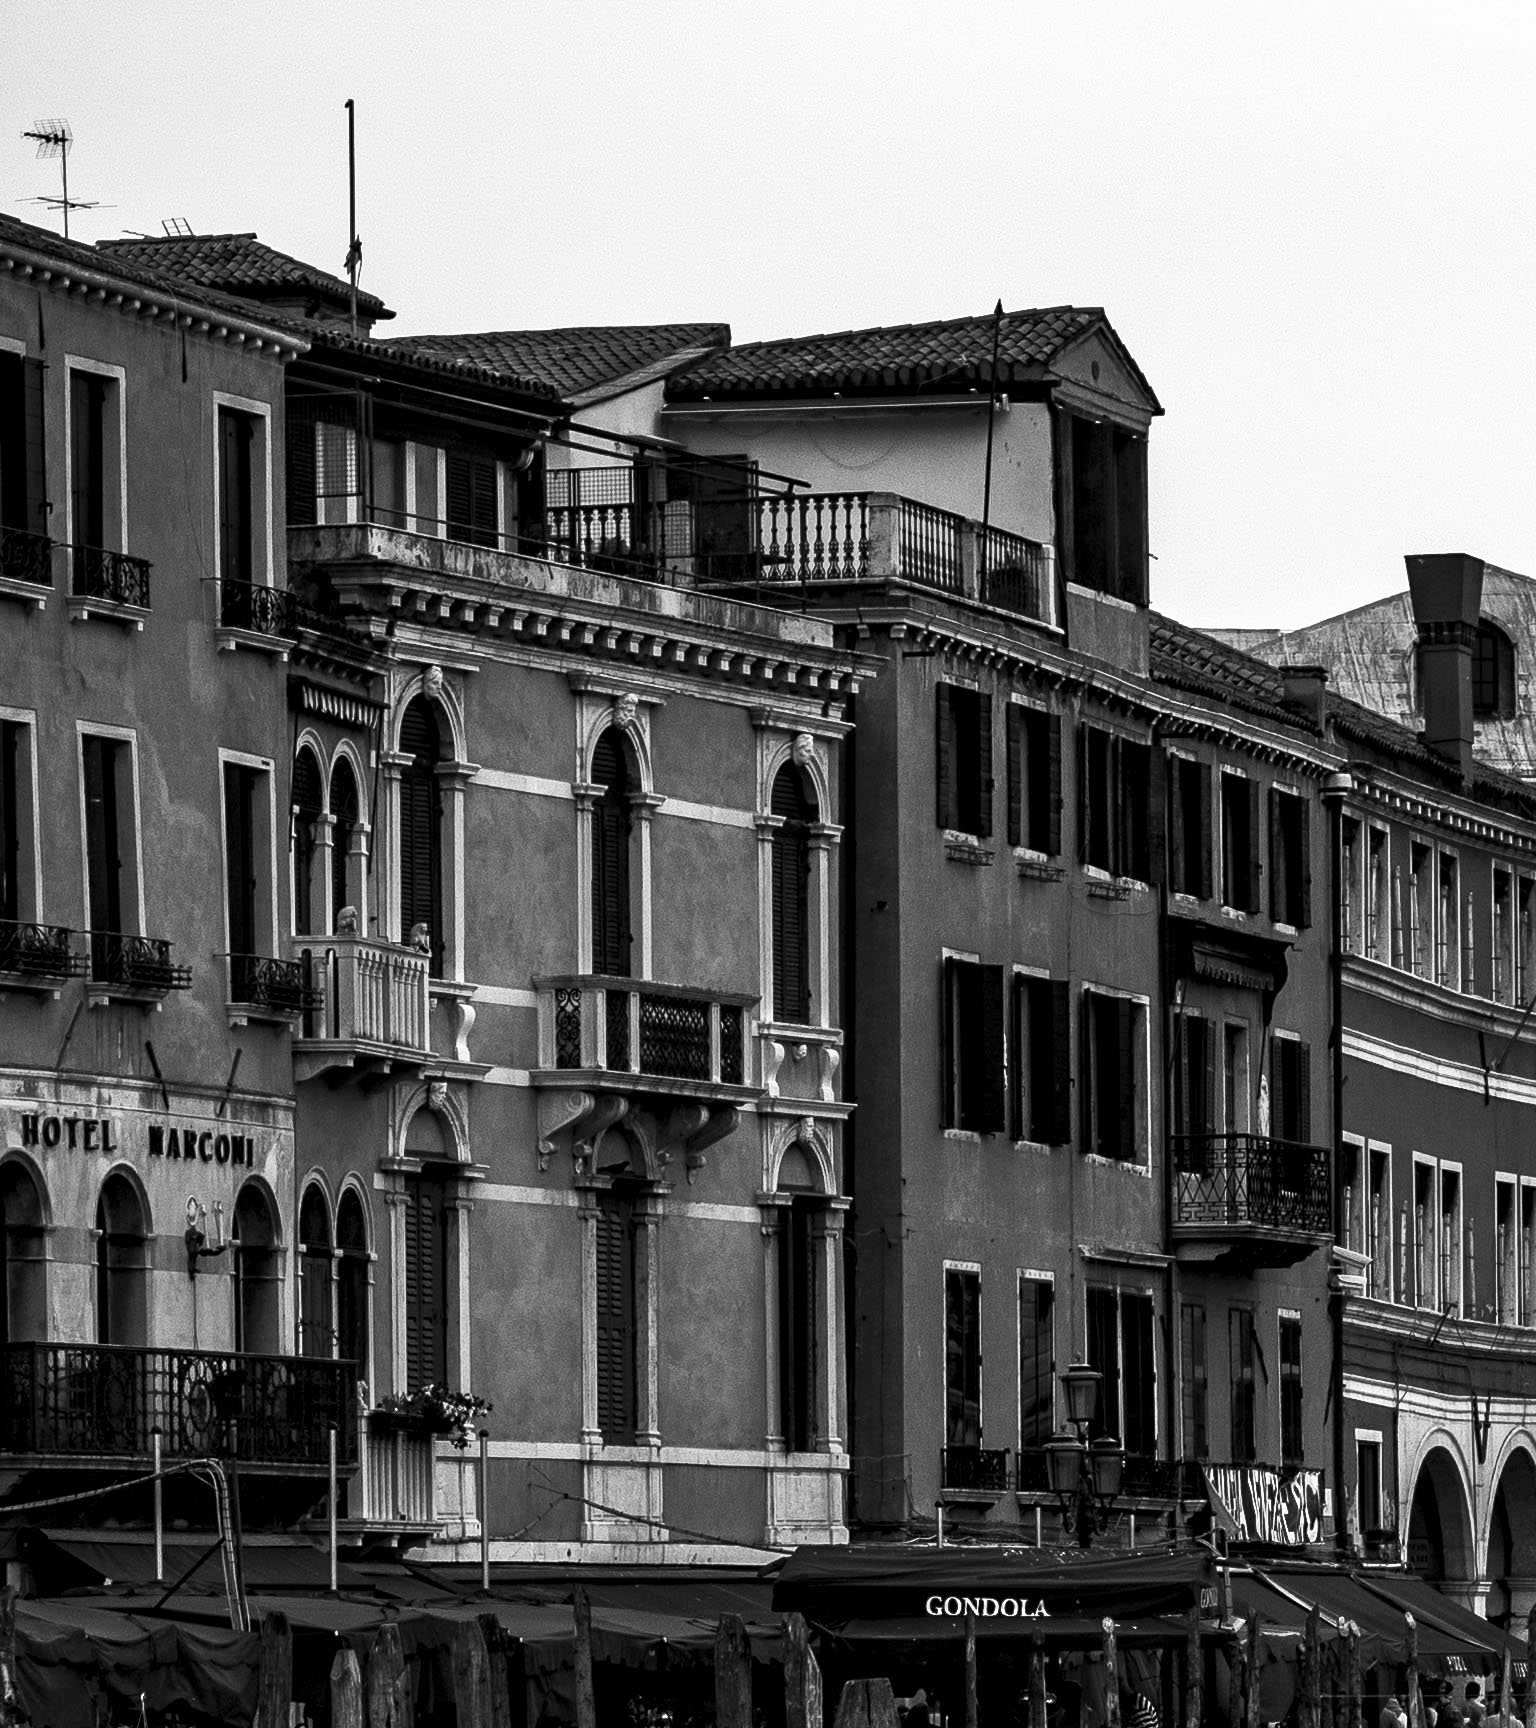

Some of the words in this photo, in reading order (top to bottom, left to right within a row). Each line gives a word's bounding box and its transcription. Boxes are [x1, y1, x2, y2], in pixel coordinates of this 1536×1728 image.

[21, 1112, 118, 1153] HOTEL
[147, 1124, 255, 1169] MARCONI
[925, 1595, 1051, 1617] GONDOLA
